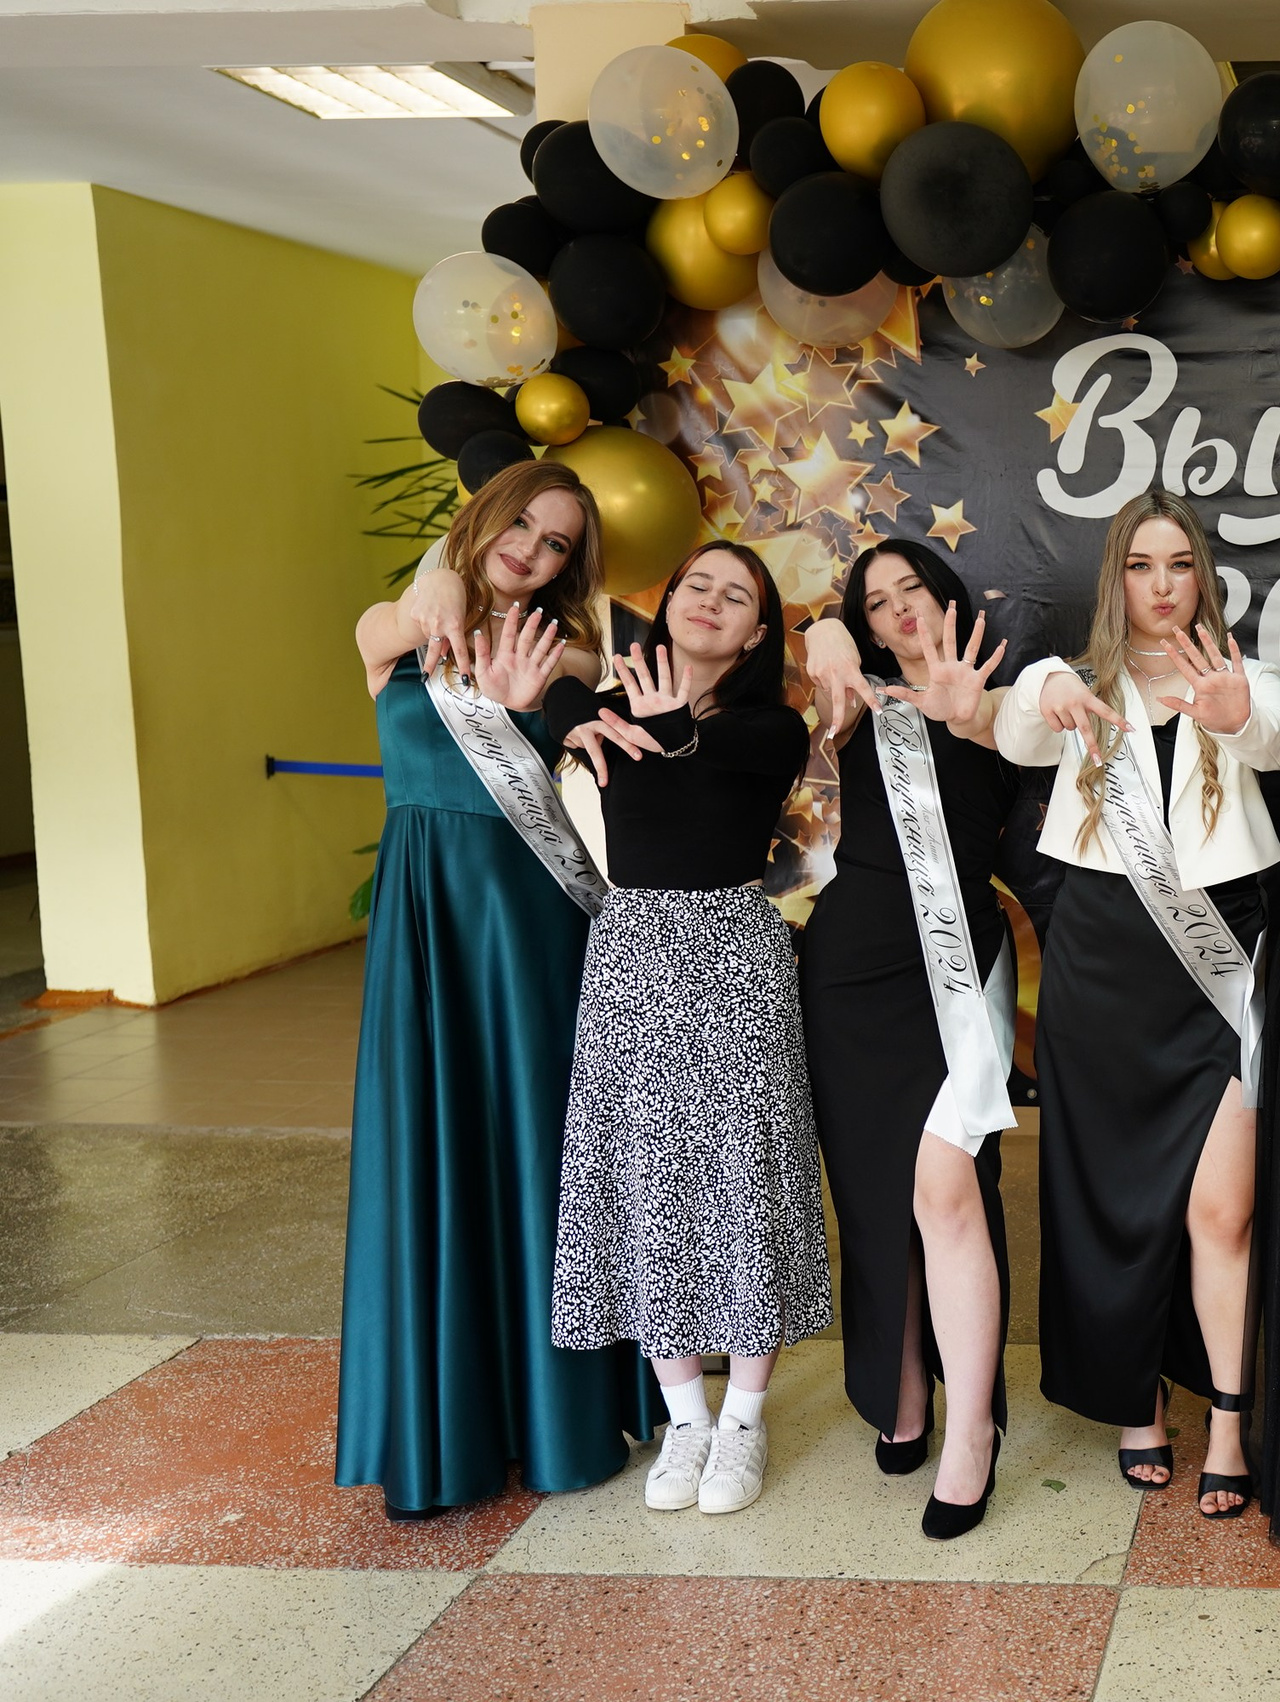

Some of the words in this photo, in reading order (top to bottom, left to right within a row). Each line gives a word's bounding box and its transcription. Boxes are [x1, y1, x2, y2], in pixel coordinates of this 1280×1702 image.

[878, 708, 937, 899] Выпускница
[920, 903, 968, 995] 2024
[1166, 903, 1244, 978] 2024
